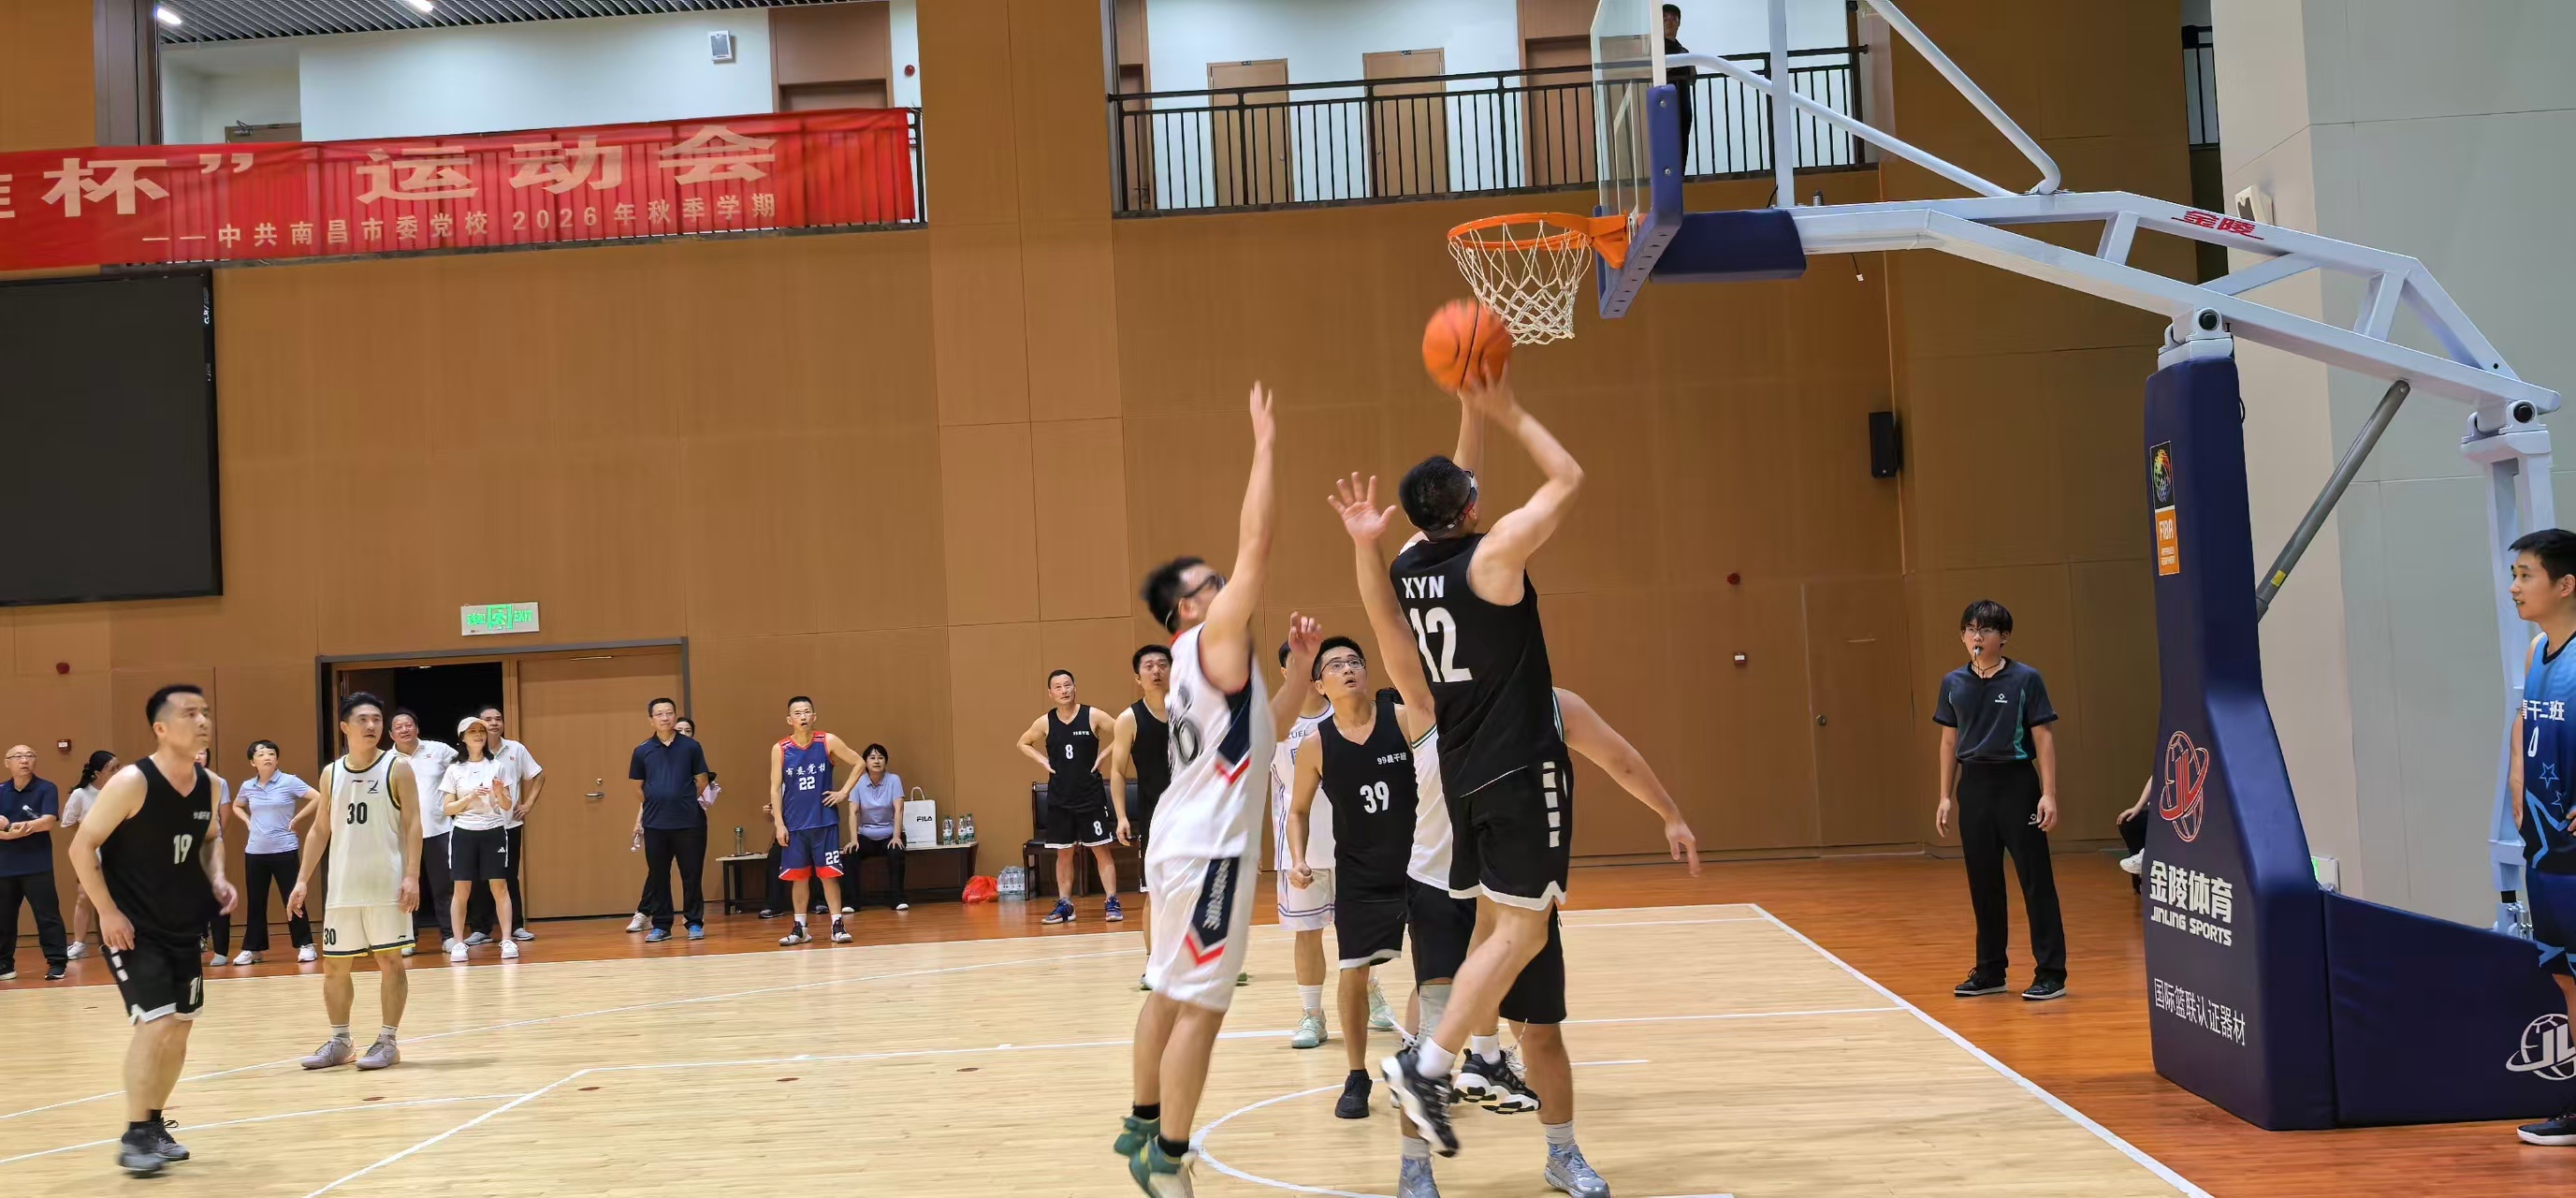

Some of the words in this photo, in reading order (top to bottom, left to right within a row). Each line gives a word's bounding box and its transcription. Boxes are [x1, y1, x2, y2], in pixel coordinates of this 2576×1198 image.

[0, 153, 254, 218] 杯”
[357, 125, 776, 204] 运动会
[1402, 576, 1444, 598] XYN
[1409, 606, 1473, 682] 12
[1065, 744, 1073, 759] 8
[799, 776, 815, 790] 22
[1360, 781, 1390, 813] 39
[347, 802, 368, 825] 30
[1093, 821, 1102, 836] 8
[174, 834, 193, 864] 19
[825, 851, 839, 865] 22
[2150, 860, 2233, 923] 金陵体育
[324, 928, 337, 945] 30
[2151, 906, 2186, 935] JINLING
[2190, 917, 2232, 946] SPORTS
[189, 975, 201, 1004] 1
[2154, 978, 2246, 1045] 国际篮联认证器材
